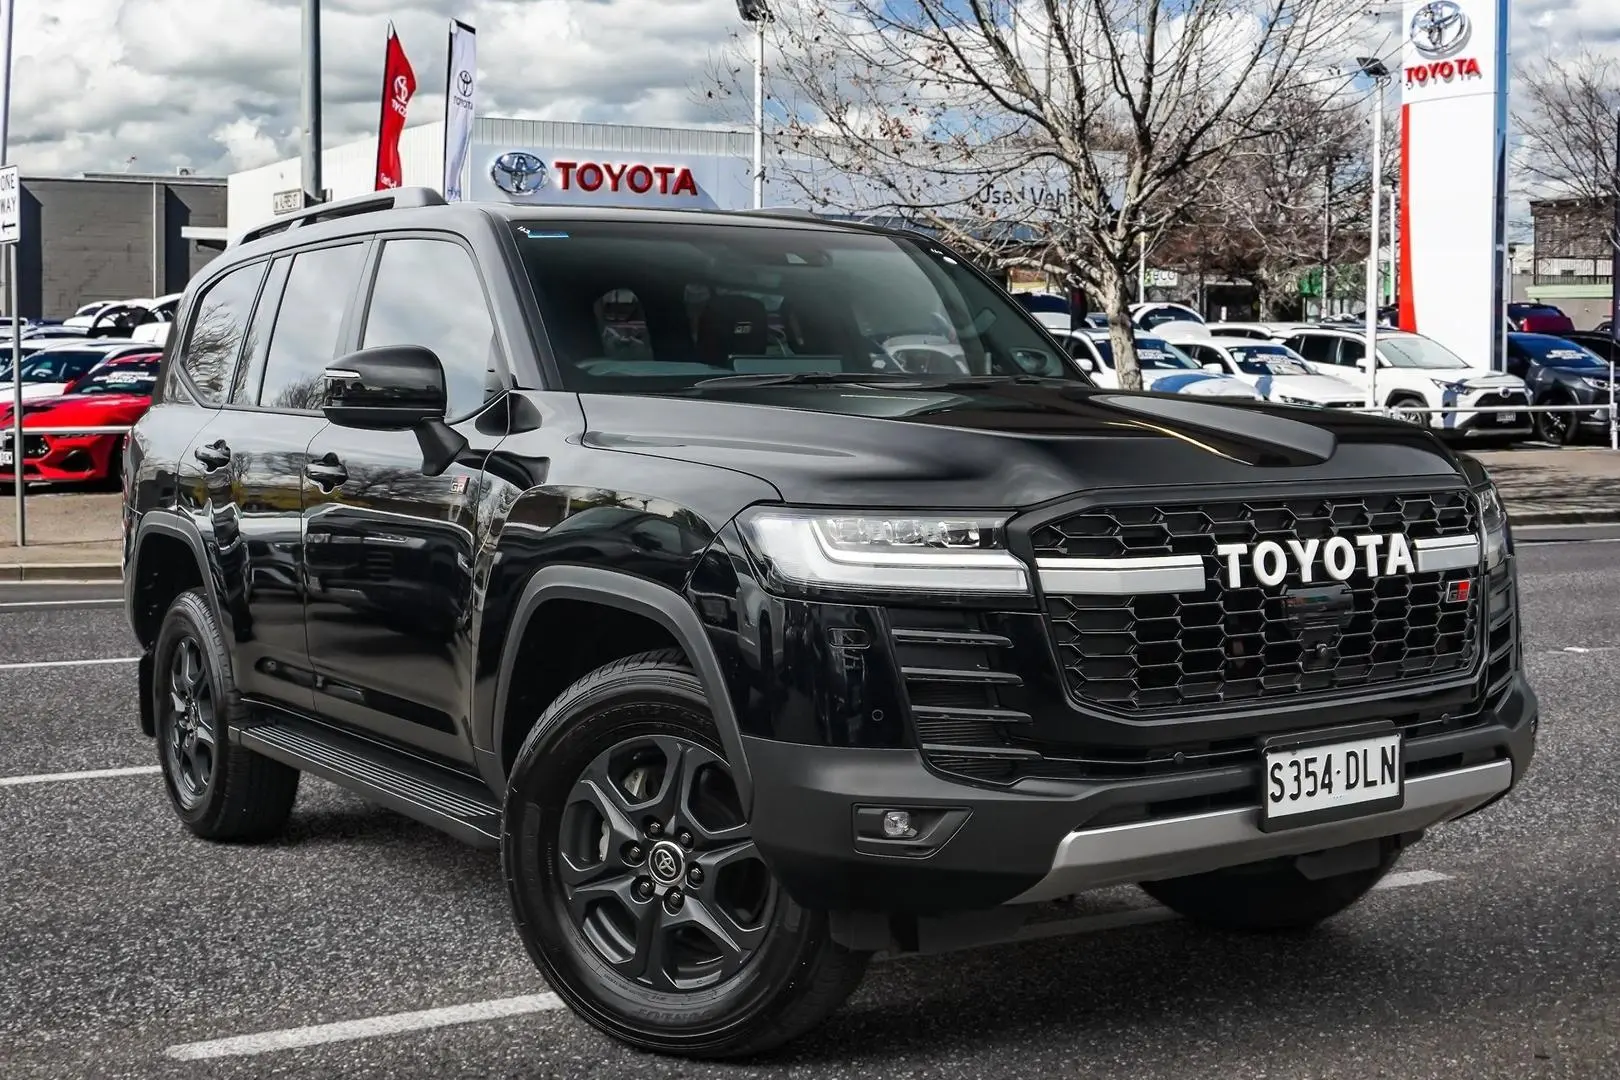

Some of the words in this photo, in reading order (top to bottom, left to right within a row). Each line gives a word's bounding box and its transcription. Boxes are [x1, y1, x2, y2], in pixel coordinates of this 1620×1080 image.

[1404, 58, 1480, 83] TOYOTA
[555, 161, 698, 196] TOYOTA
[979, 184, 1025, 205] Used
[1217, 533, 1415, 588] TOYOTA
